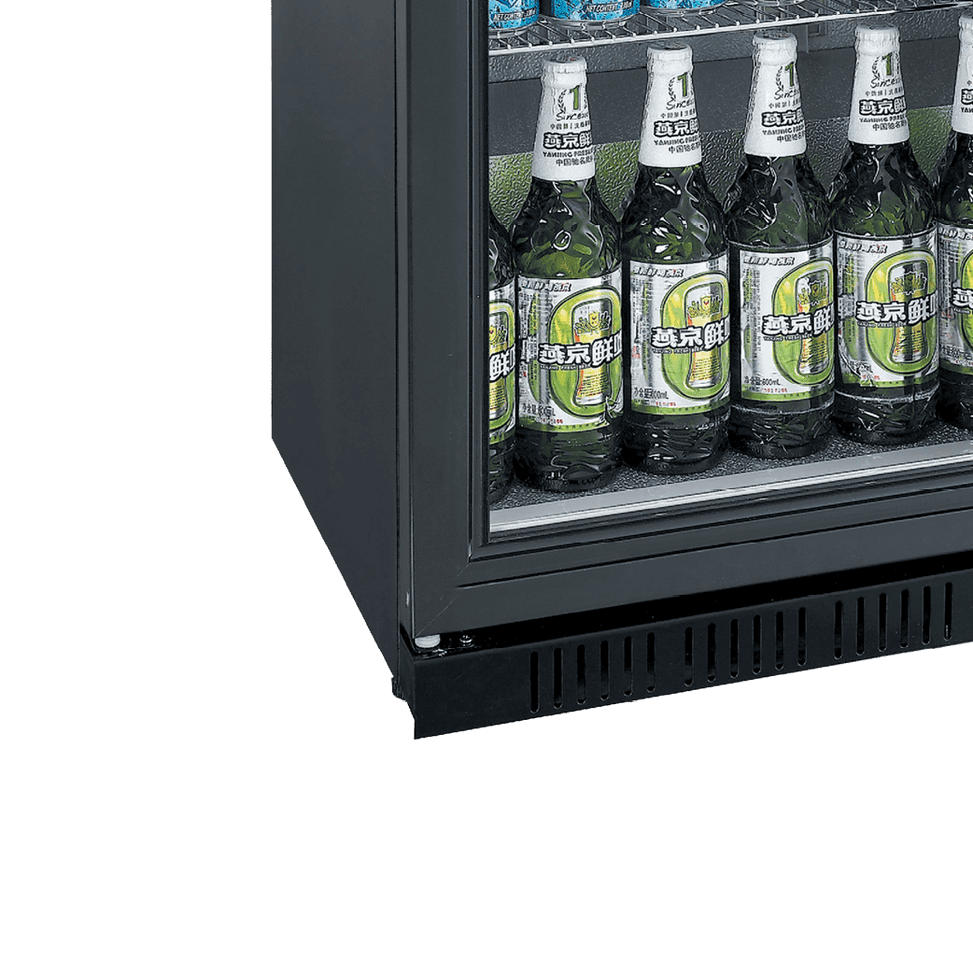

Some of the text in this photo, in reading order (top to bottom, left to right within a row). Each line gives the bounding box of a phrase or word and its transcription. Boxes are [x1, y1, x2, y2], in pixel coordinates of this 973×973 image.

[785, 61, 794, 86] 1
[882, 52, 892, 75] 1
[569, 84, 580, 110] 1
[678, 72, 688, 97] 1
[762, 301, 835, 337] 燕京鲜
[855, 289, 938, 326] 燕京鲜
[651, 314, 730, 351] 燕京鲜
[538, 330, 622, 367] 燕京鲜
